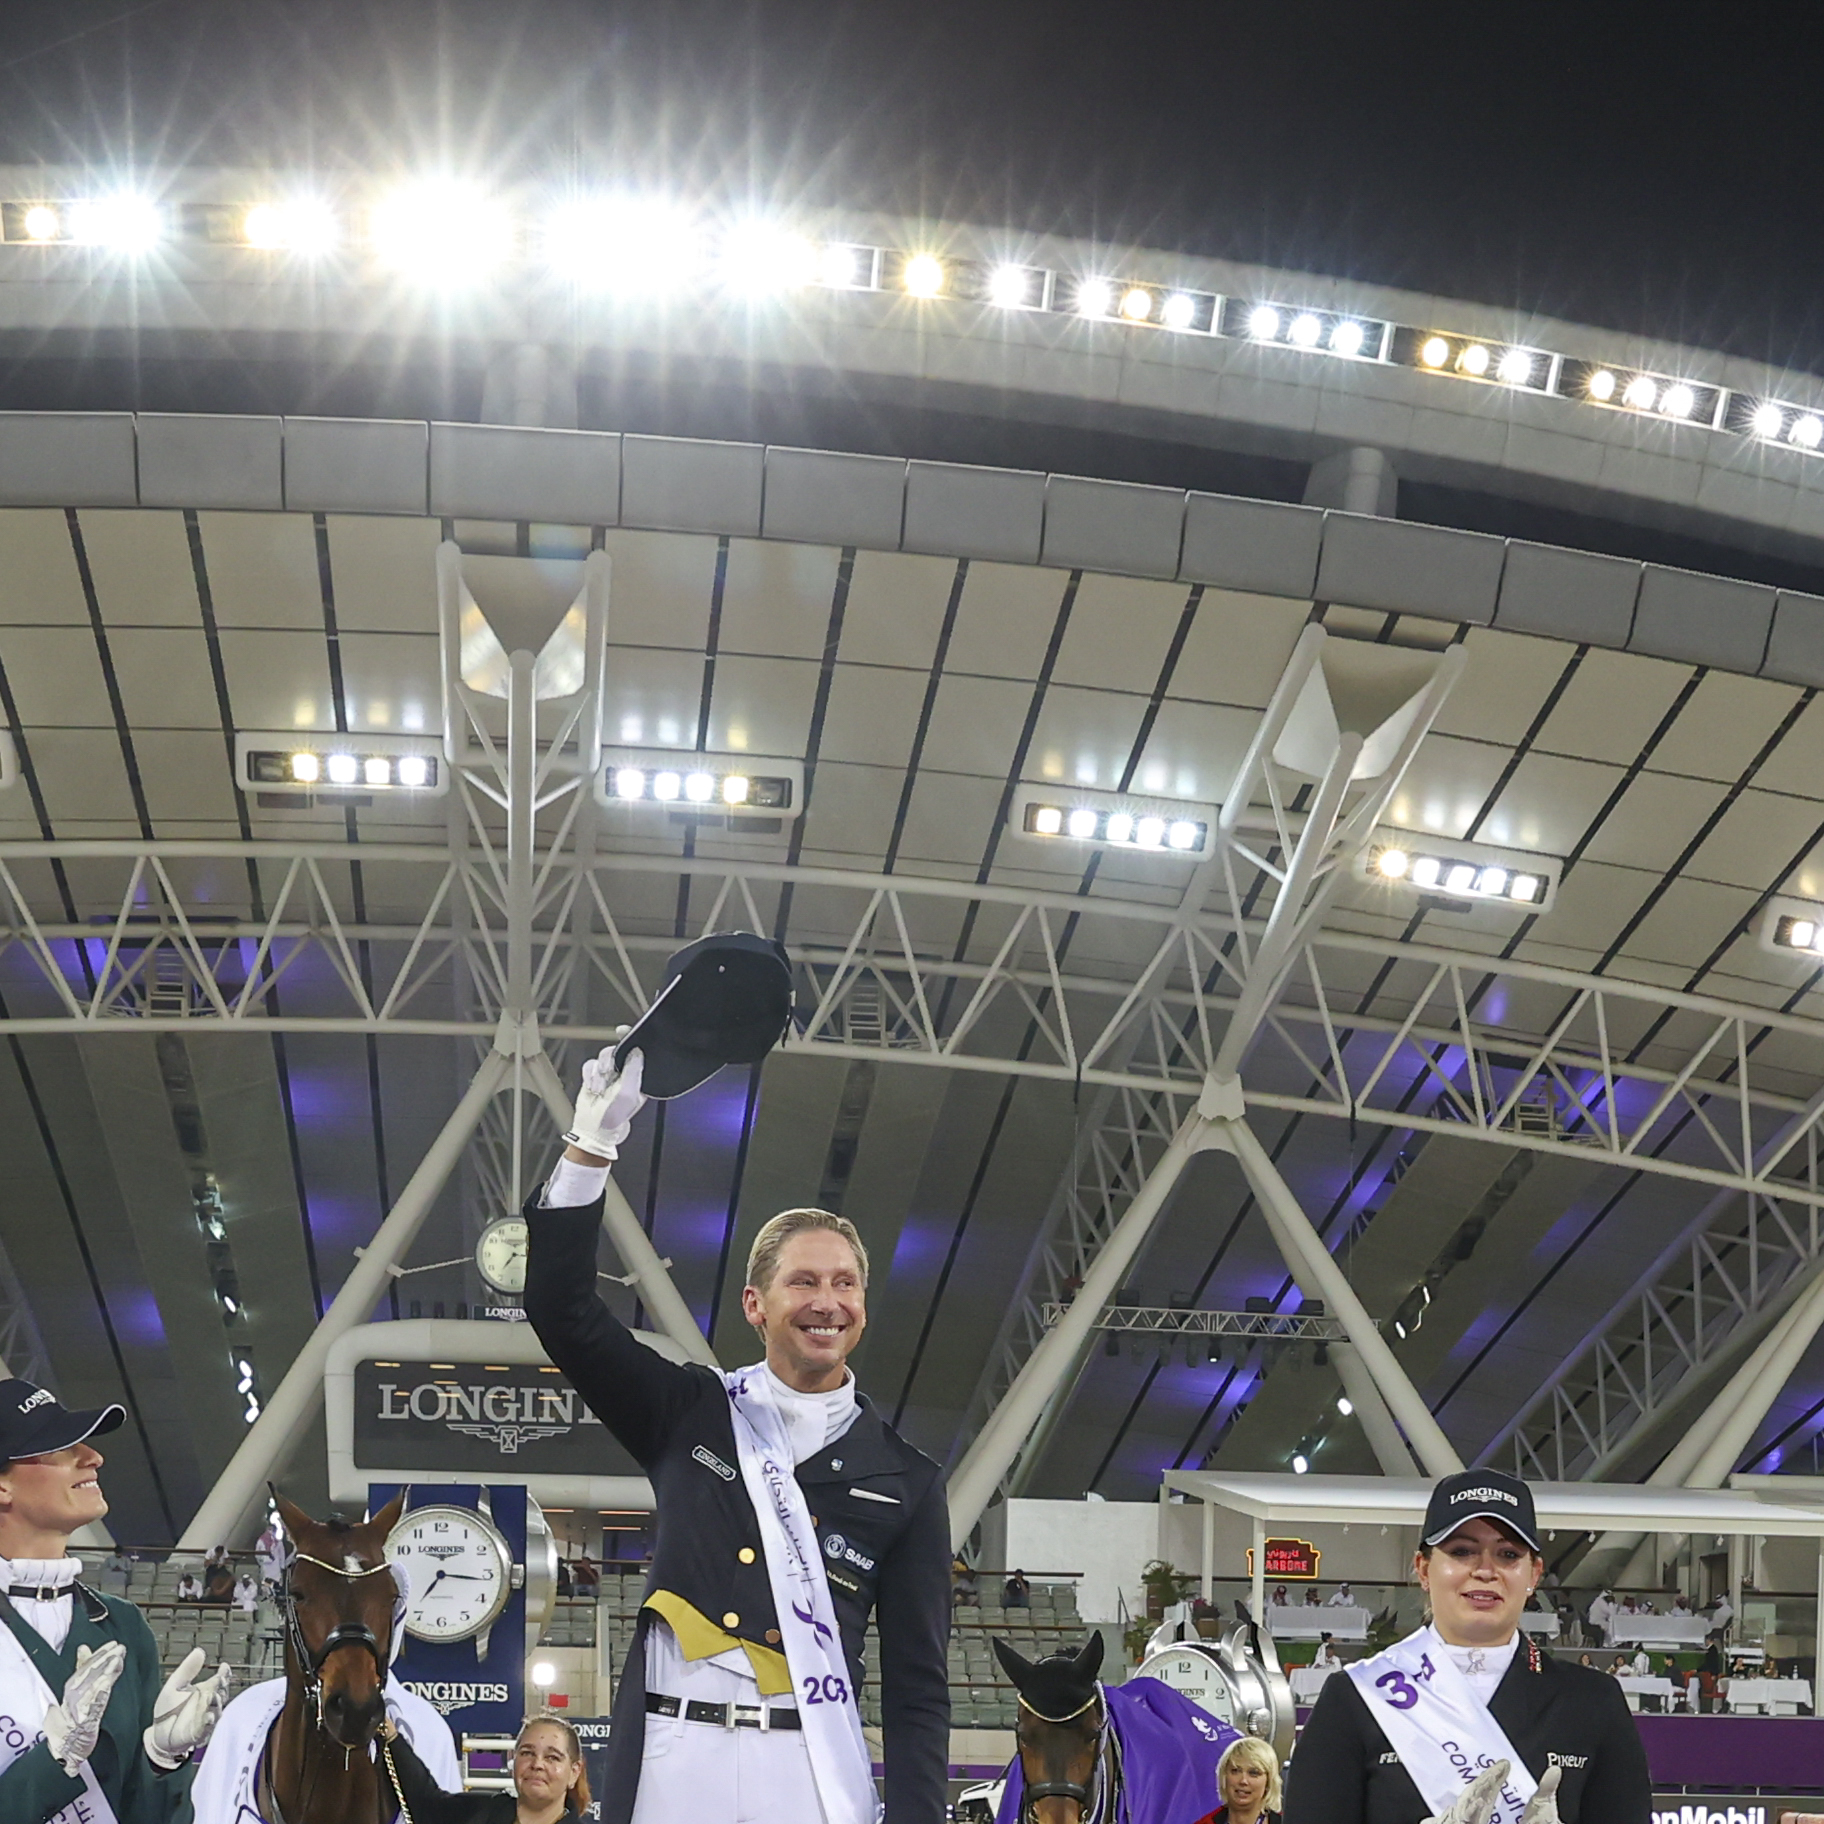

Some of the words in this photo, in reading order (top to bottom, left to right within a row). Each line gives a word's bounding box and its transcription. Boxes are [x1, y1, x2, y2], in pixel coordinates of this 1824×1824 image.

[485, 1307, 528, 1318] LONGIN
[377, 1383, 603, 1424] LONGIN
[1449, 1486, 1519, 1507] LONGINES
[434, 1522, 449, 1533] 12
[413, 1529, 423, 1539] 11
[464, 1529, 468, 1539] 1
[397, 1545, 411, 1556] 10
[476, 1544, 487, 1556] 2
[844, 1548, 875, 1570] SAAB
[1265, 1560, 1308, 1571] ARBONE
[482, 1569, 494, 1581] 3
[475, 1593, 487, 1604] 4
[413, 1610, 424, 1621] 7
[459, 1611, 470, 1621] 5
[436, 1616, 447, 1628] 6
[402, 1681, 508, 1702] ONGINES
